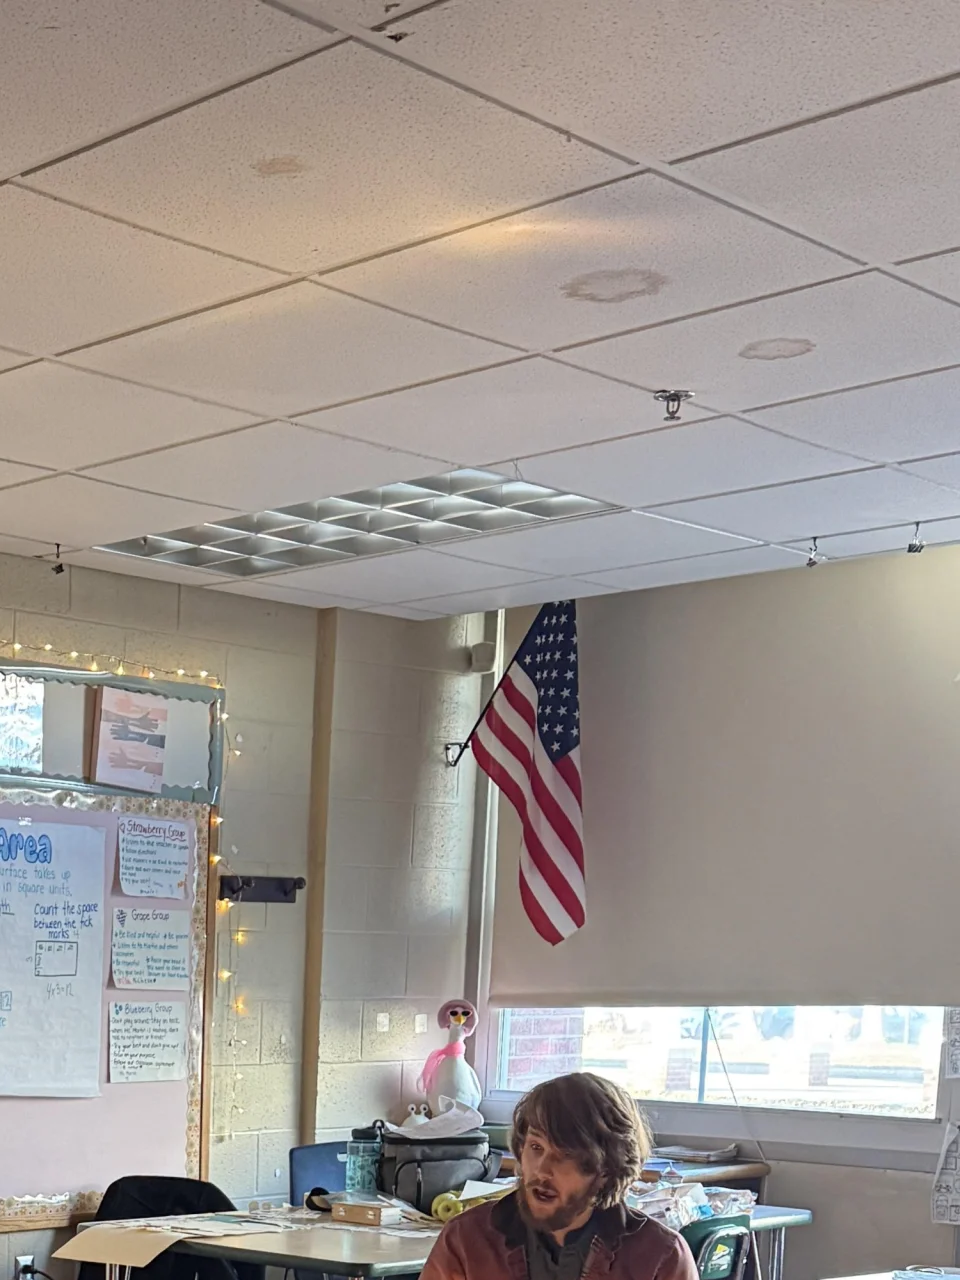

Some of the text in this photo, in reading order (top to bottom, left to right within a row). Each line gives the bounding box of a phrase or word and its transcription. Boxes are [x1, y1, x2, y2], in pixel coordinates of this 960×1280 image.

[127, 820, 185, 842] Strawberry Group
[34, 867, 55, 880] takes
[61, 870, 71, 882] up
[3, 880, 12, 892] in
[18, 882, 44, 898] square
[34, 902, 98, 918] Count the space
[132, 908, 169, 921] Grape Group
[34, 916, 93, 929] between the tick
[48, 929, 69, 939] marks
[125, 1002, 172, 1020] Blueberry Group
